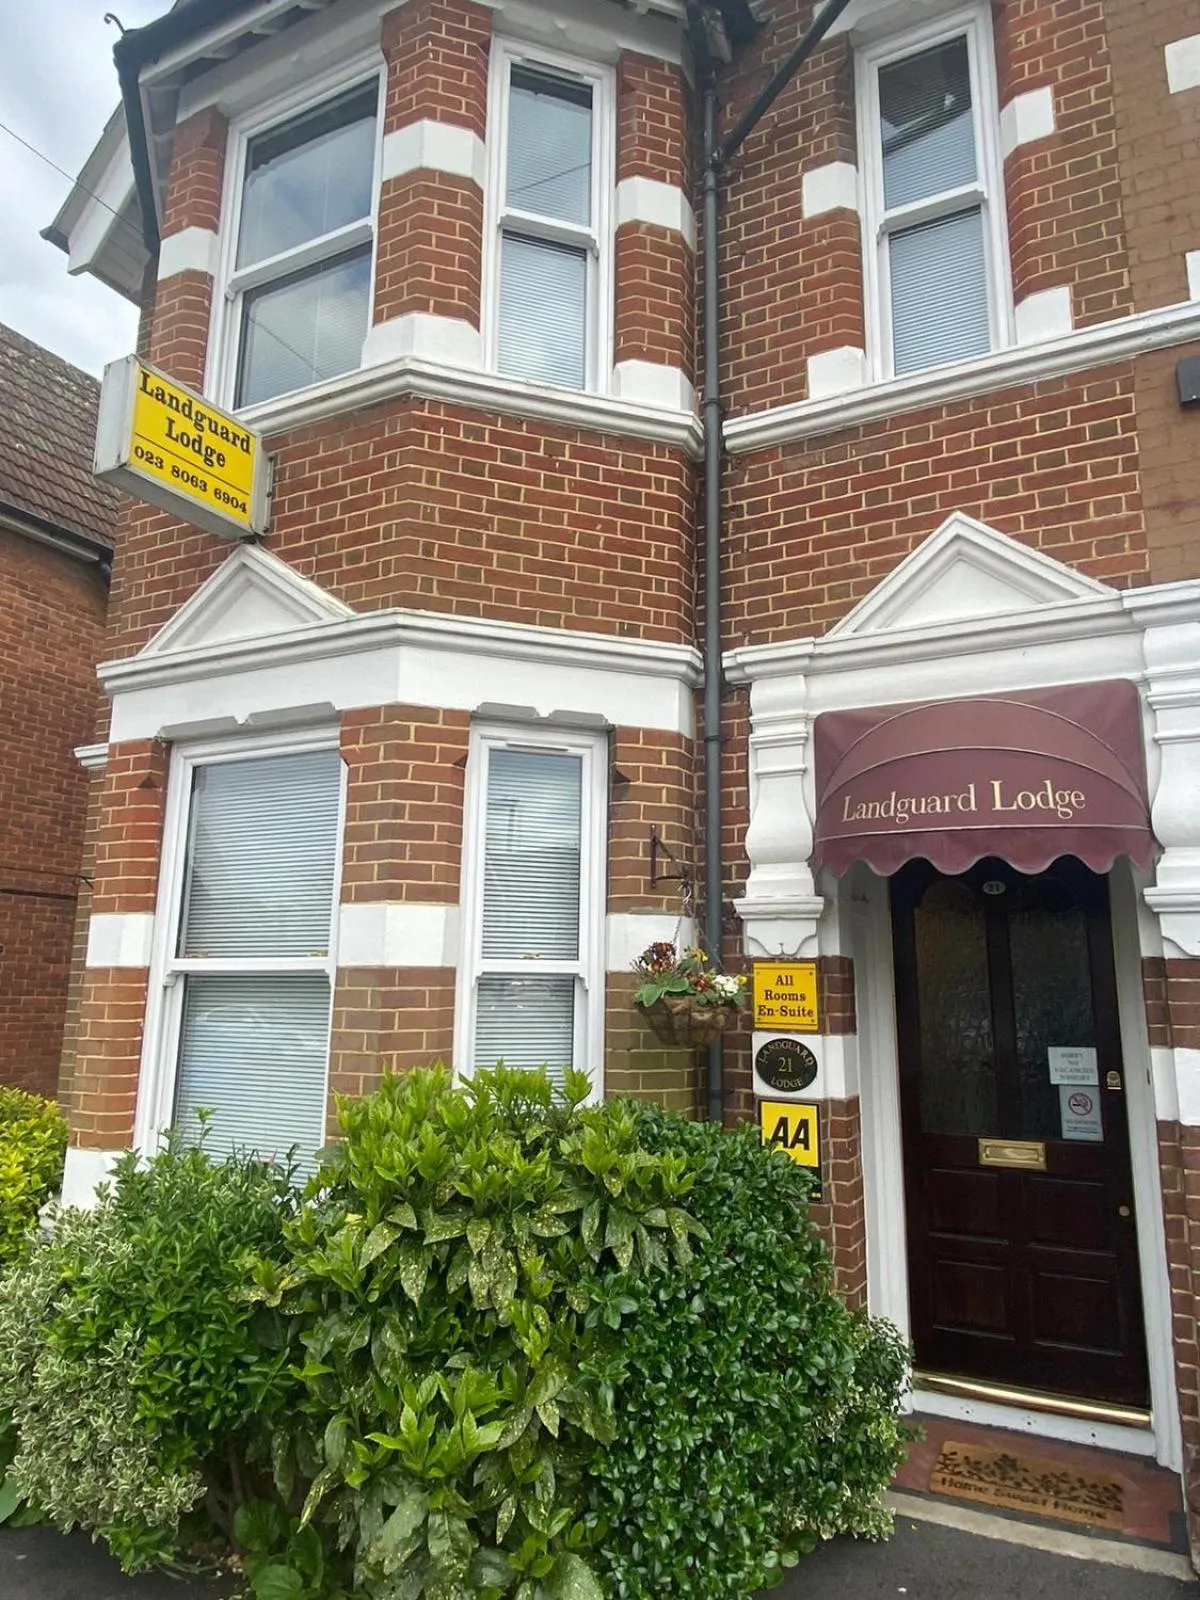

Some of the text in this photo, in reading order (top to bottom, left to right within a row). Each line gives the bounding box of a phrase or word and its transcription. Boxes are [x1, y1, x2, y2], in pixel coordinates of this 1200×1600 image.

[140, 370, 251, 455] Landguard
[165, 417, 226, 468] Lodge
[134, 445, 248, 514] 023 8063 6904
[841, 779, 1086, 824] Landguard Lodge
[775, 974, 794, 986] All
[764, 989, 806, 1002] Rooms
[757, 1005, 814, 1018] En-Suite
[758, 1040, 815, 1067] LANDGUARD
[778, 1056, 793, 1073] 21
[771, 1076, 804, 1089] LODGE
[769, 1116, 810, 1151] AA
[940, 1476, 988, 1494] Home
